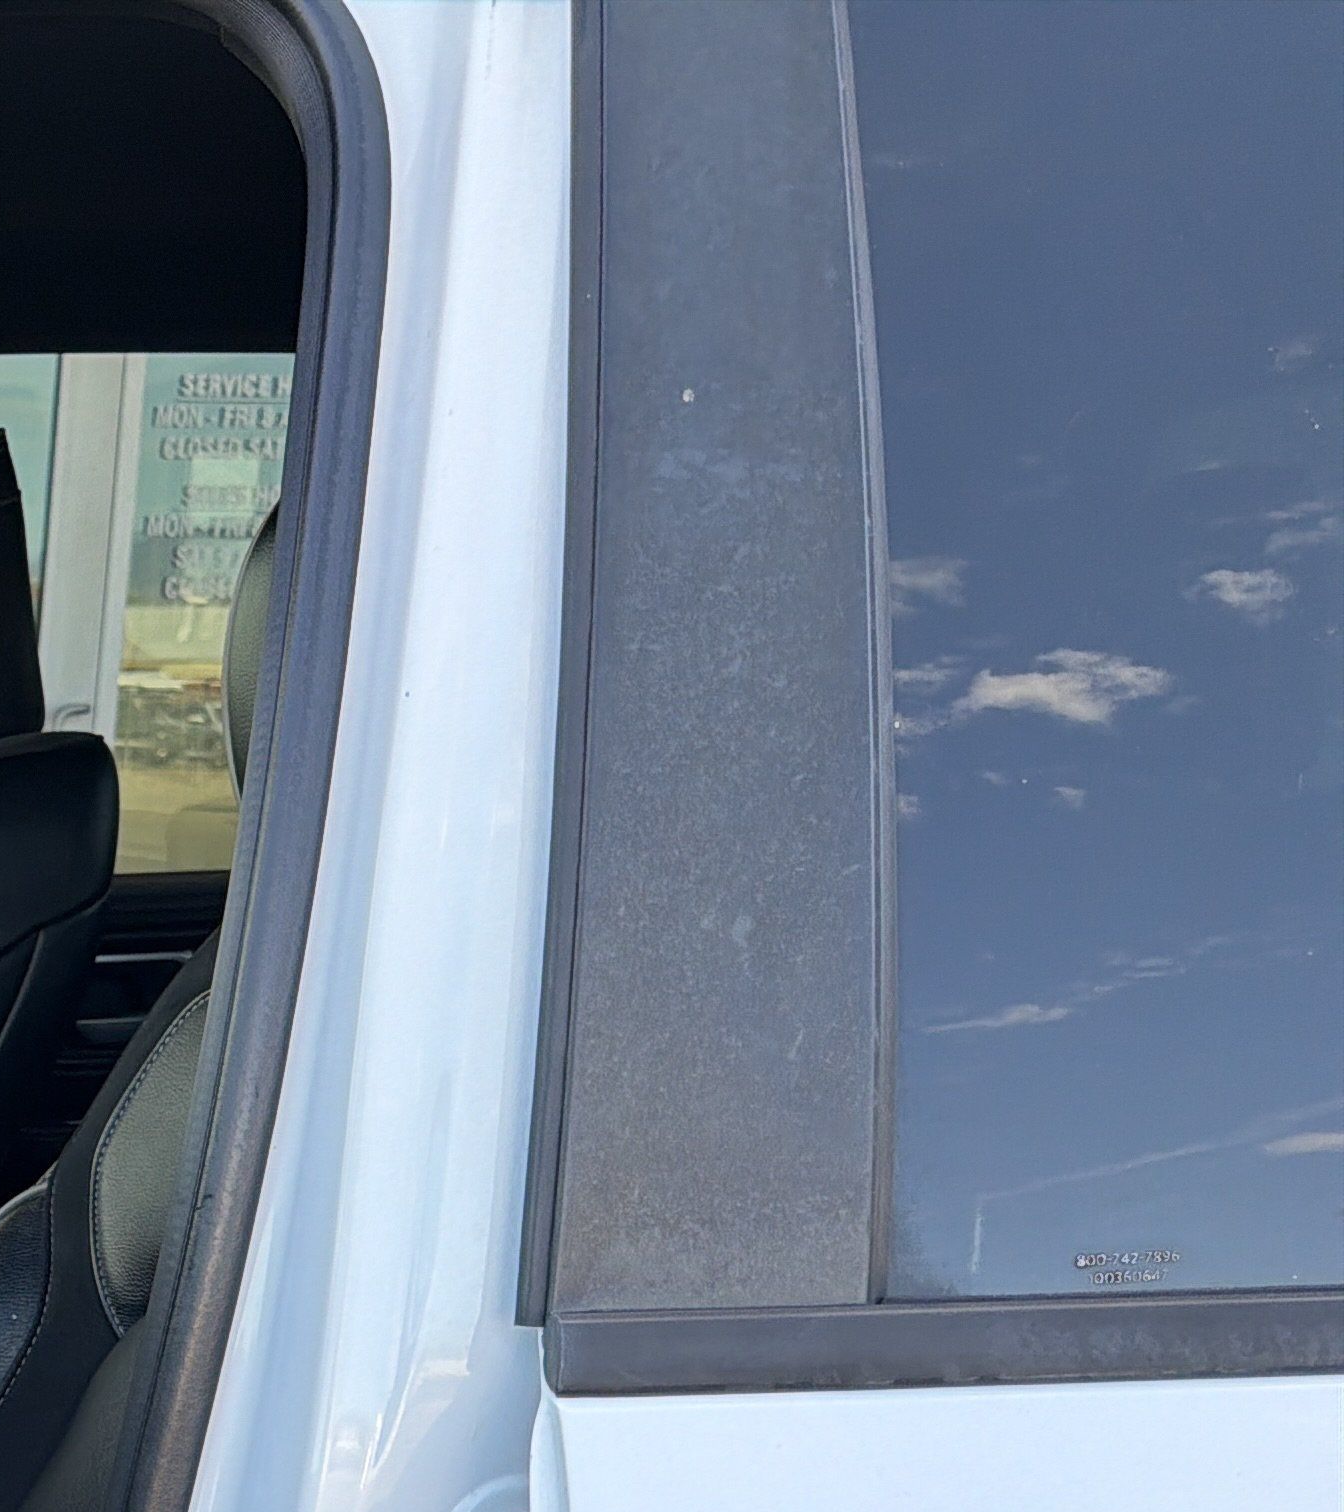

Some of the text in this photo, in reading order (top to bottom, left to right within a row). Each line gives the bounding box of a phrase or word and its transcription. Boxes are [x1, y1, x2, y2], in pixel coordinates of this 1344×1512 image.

[178, 373, 270, 397] SERVICE
[152, 405, 203, 428] MON
[144, 515, 192, 538] MON
